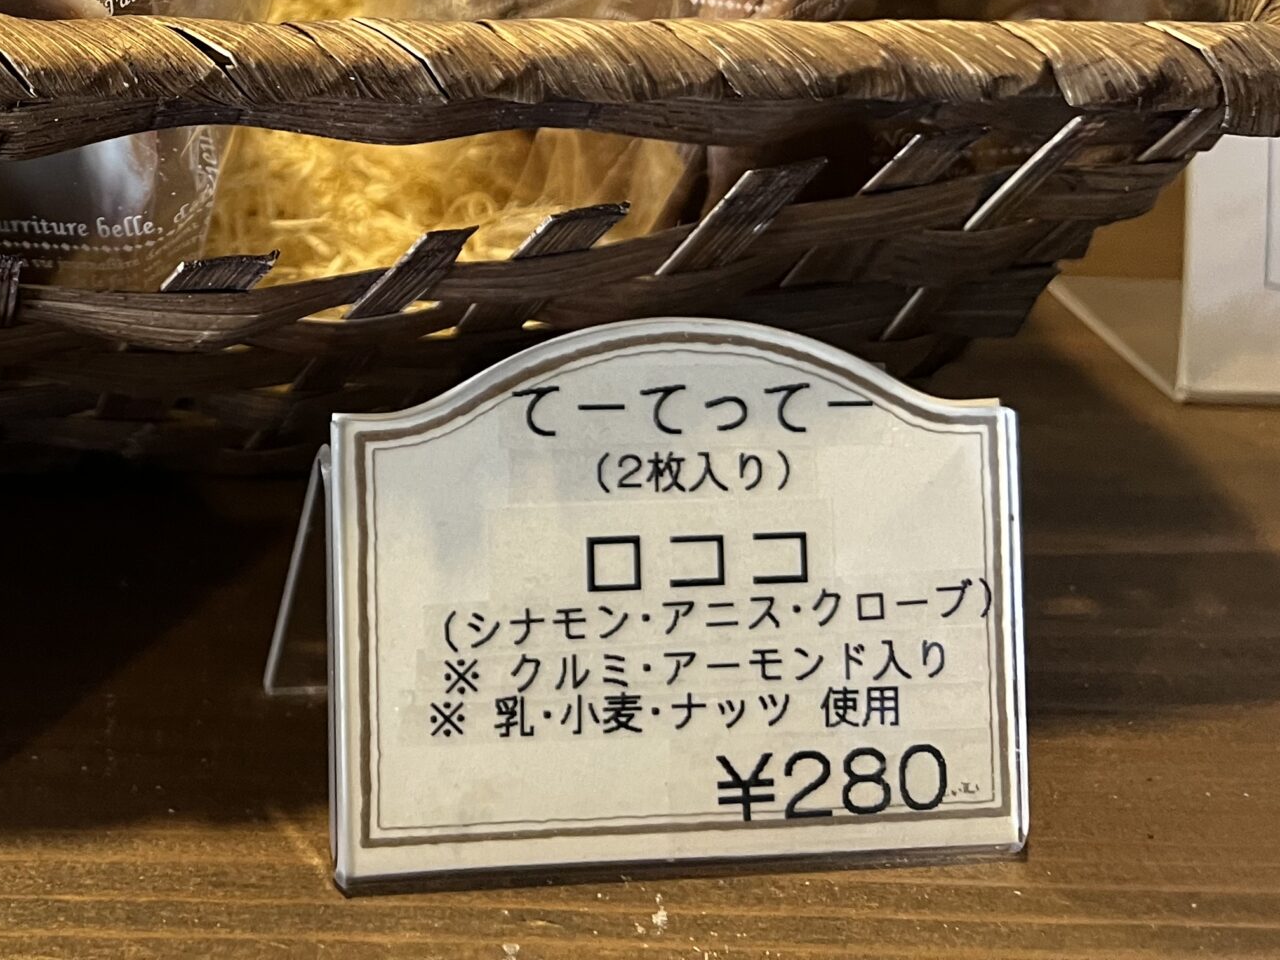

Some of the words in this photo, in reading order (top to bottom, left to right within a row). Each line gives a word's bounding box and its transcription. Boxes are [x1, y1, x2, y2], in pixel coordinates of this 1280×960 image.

[95, 214, 163, 238] belle,
[513, 383, 873, 437] てーてってー
[586, 531, 809, 593] ロココ
[511, 640, 946, 692] クルミ・アーモンド入り
[495, 691, 790, 738] 乳・小麦・ナッツ
[820, 686, 899, 728] 使用
[716, 744, 948, 821] ¥280
